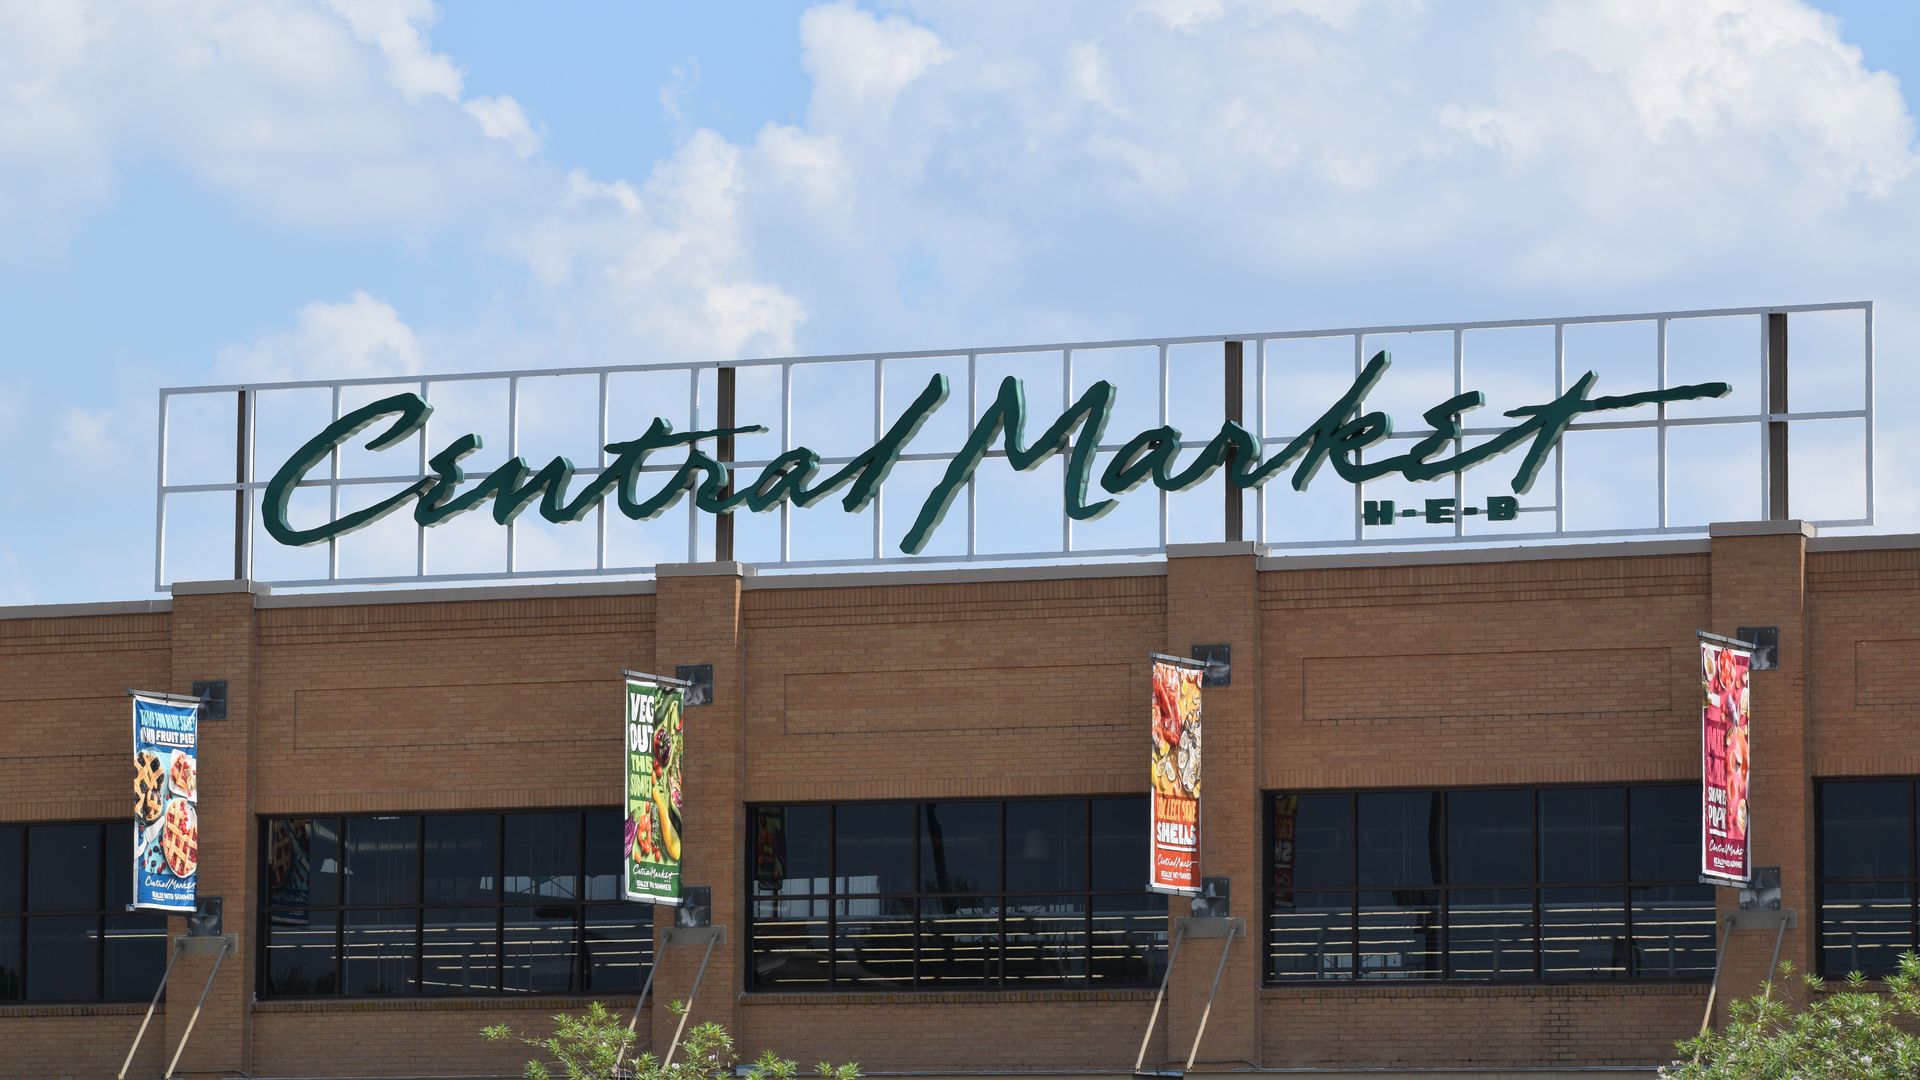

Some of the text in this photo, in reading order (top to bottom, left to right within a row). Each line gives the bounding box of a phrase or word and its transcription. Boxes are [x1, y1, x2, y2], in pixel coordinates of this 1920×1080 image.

[262, 350, 1733, 555] Central Market
[1363, 495, 1519, 525] H-E-B
[630, 692, 655, 723] VEG
[156, 730, 180, 744] FRUIT
[630, 722, 654, 753] OUT
[1156, 821, 1197, 846] SHELLS
